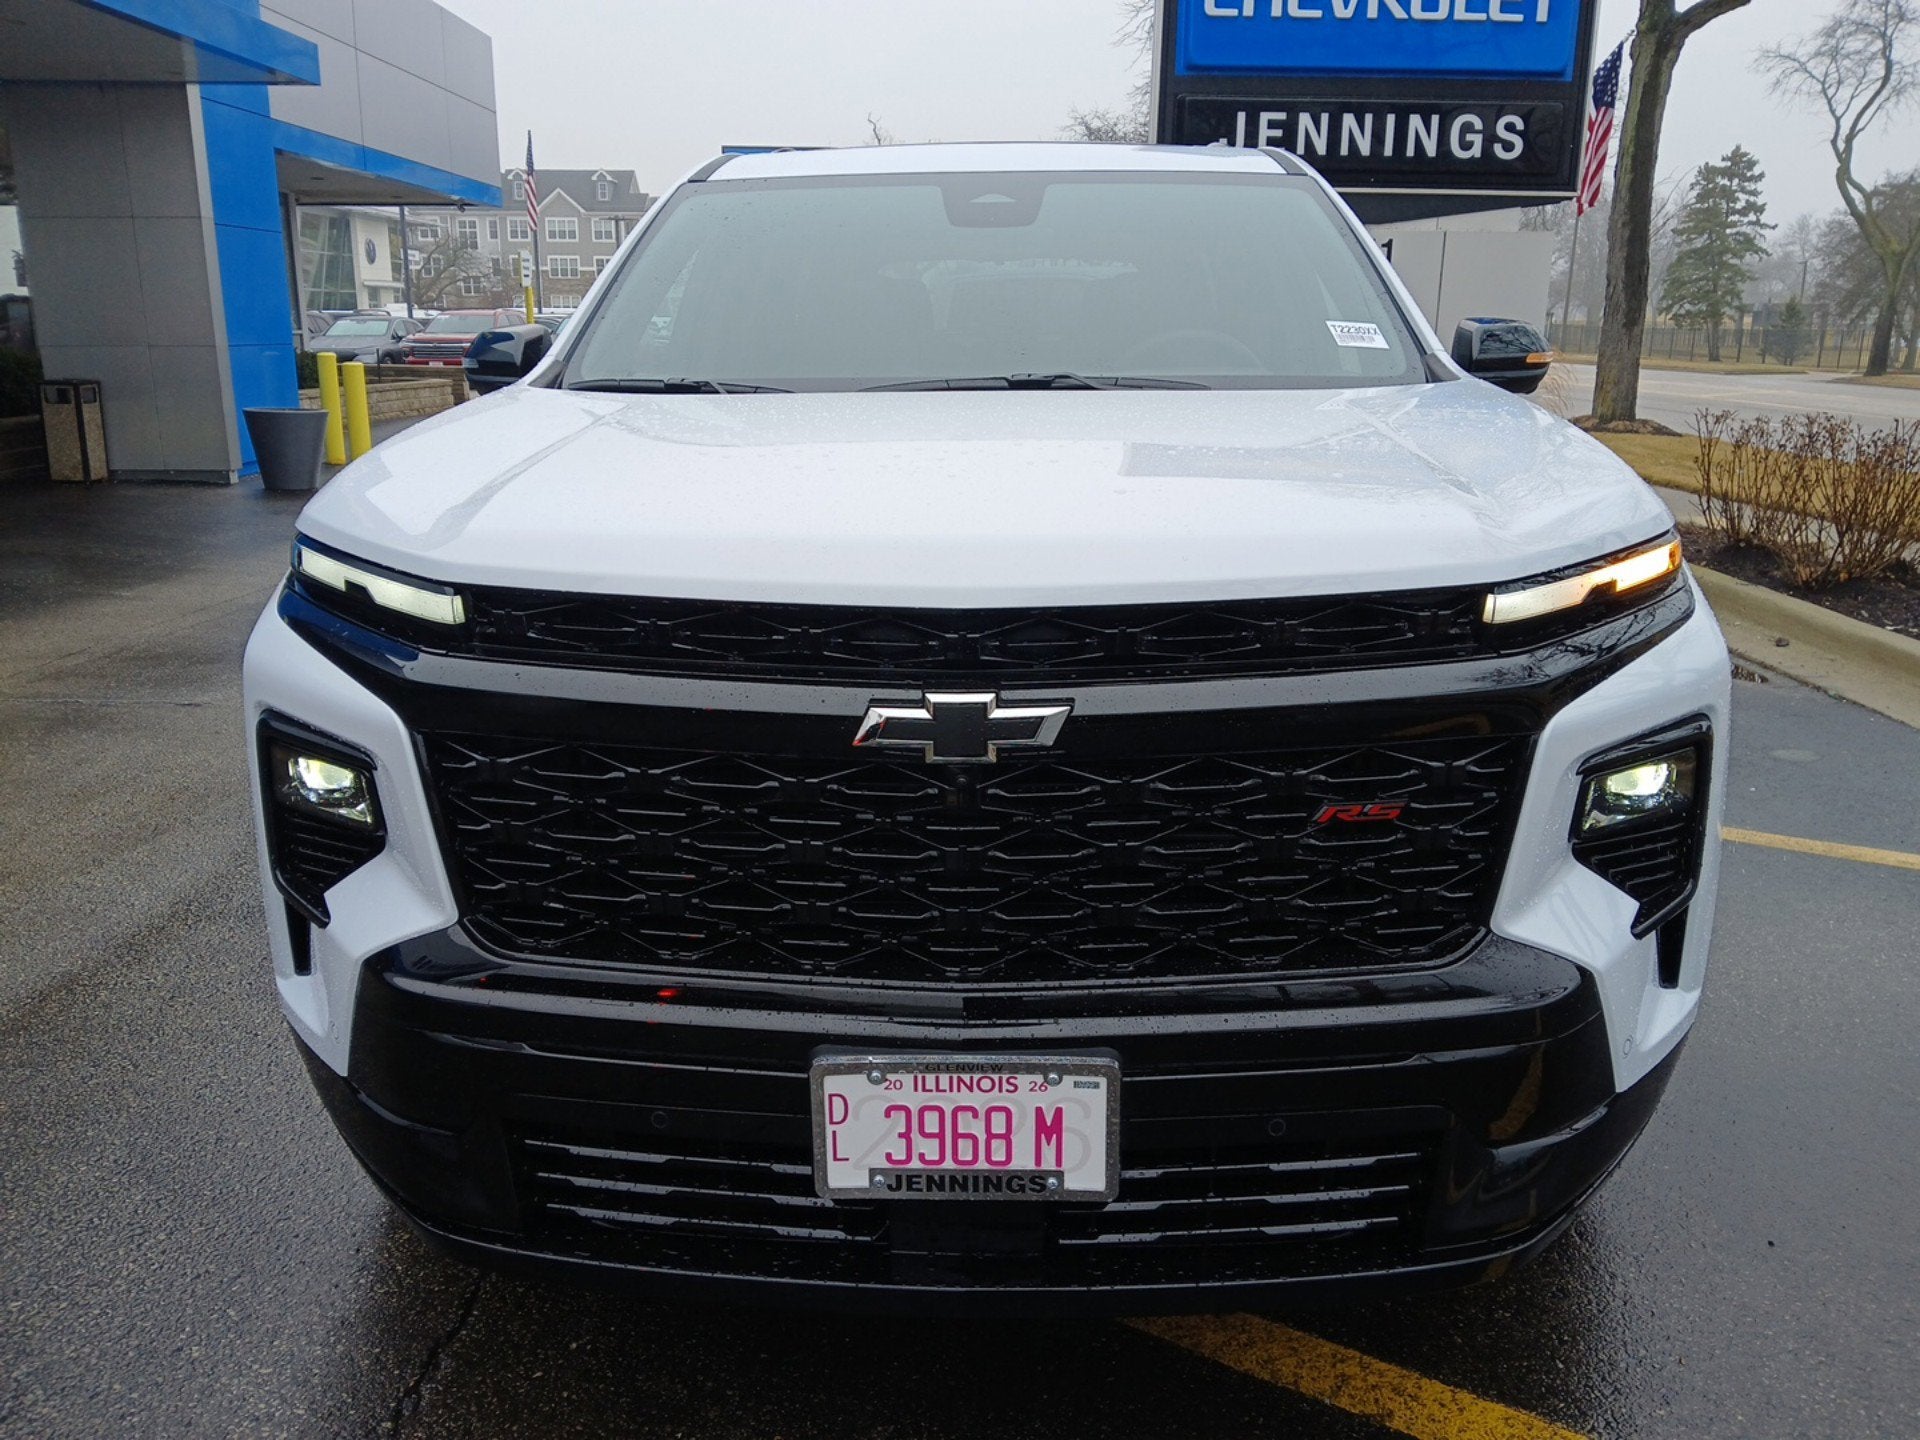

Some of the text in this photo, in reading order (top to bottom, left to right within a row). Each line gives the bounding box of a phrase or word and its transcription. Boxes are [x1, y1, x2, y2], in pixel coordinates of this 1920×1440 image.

[1219, 111, 1525, 160] JENNINGS
[1312, 802, 1407, 823] RS
[924, 1063, 1004, 1072] GLENVIEW
[883, 1075, 1049, 1093] 20 ILLINOIS 26
[883, 1104, 1064, 1168] 3968 M
[886, 1174, 1048, 1195] JENNINGS
